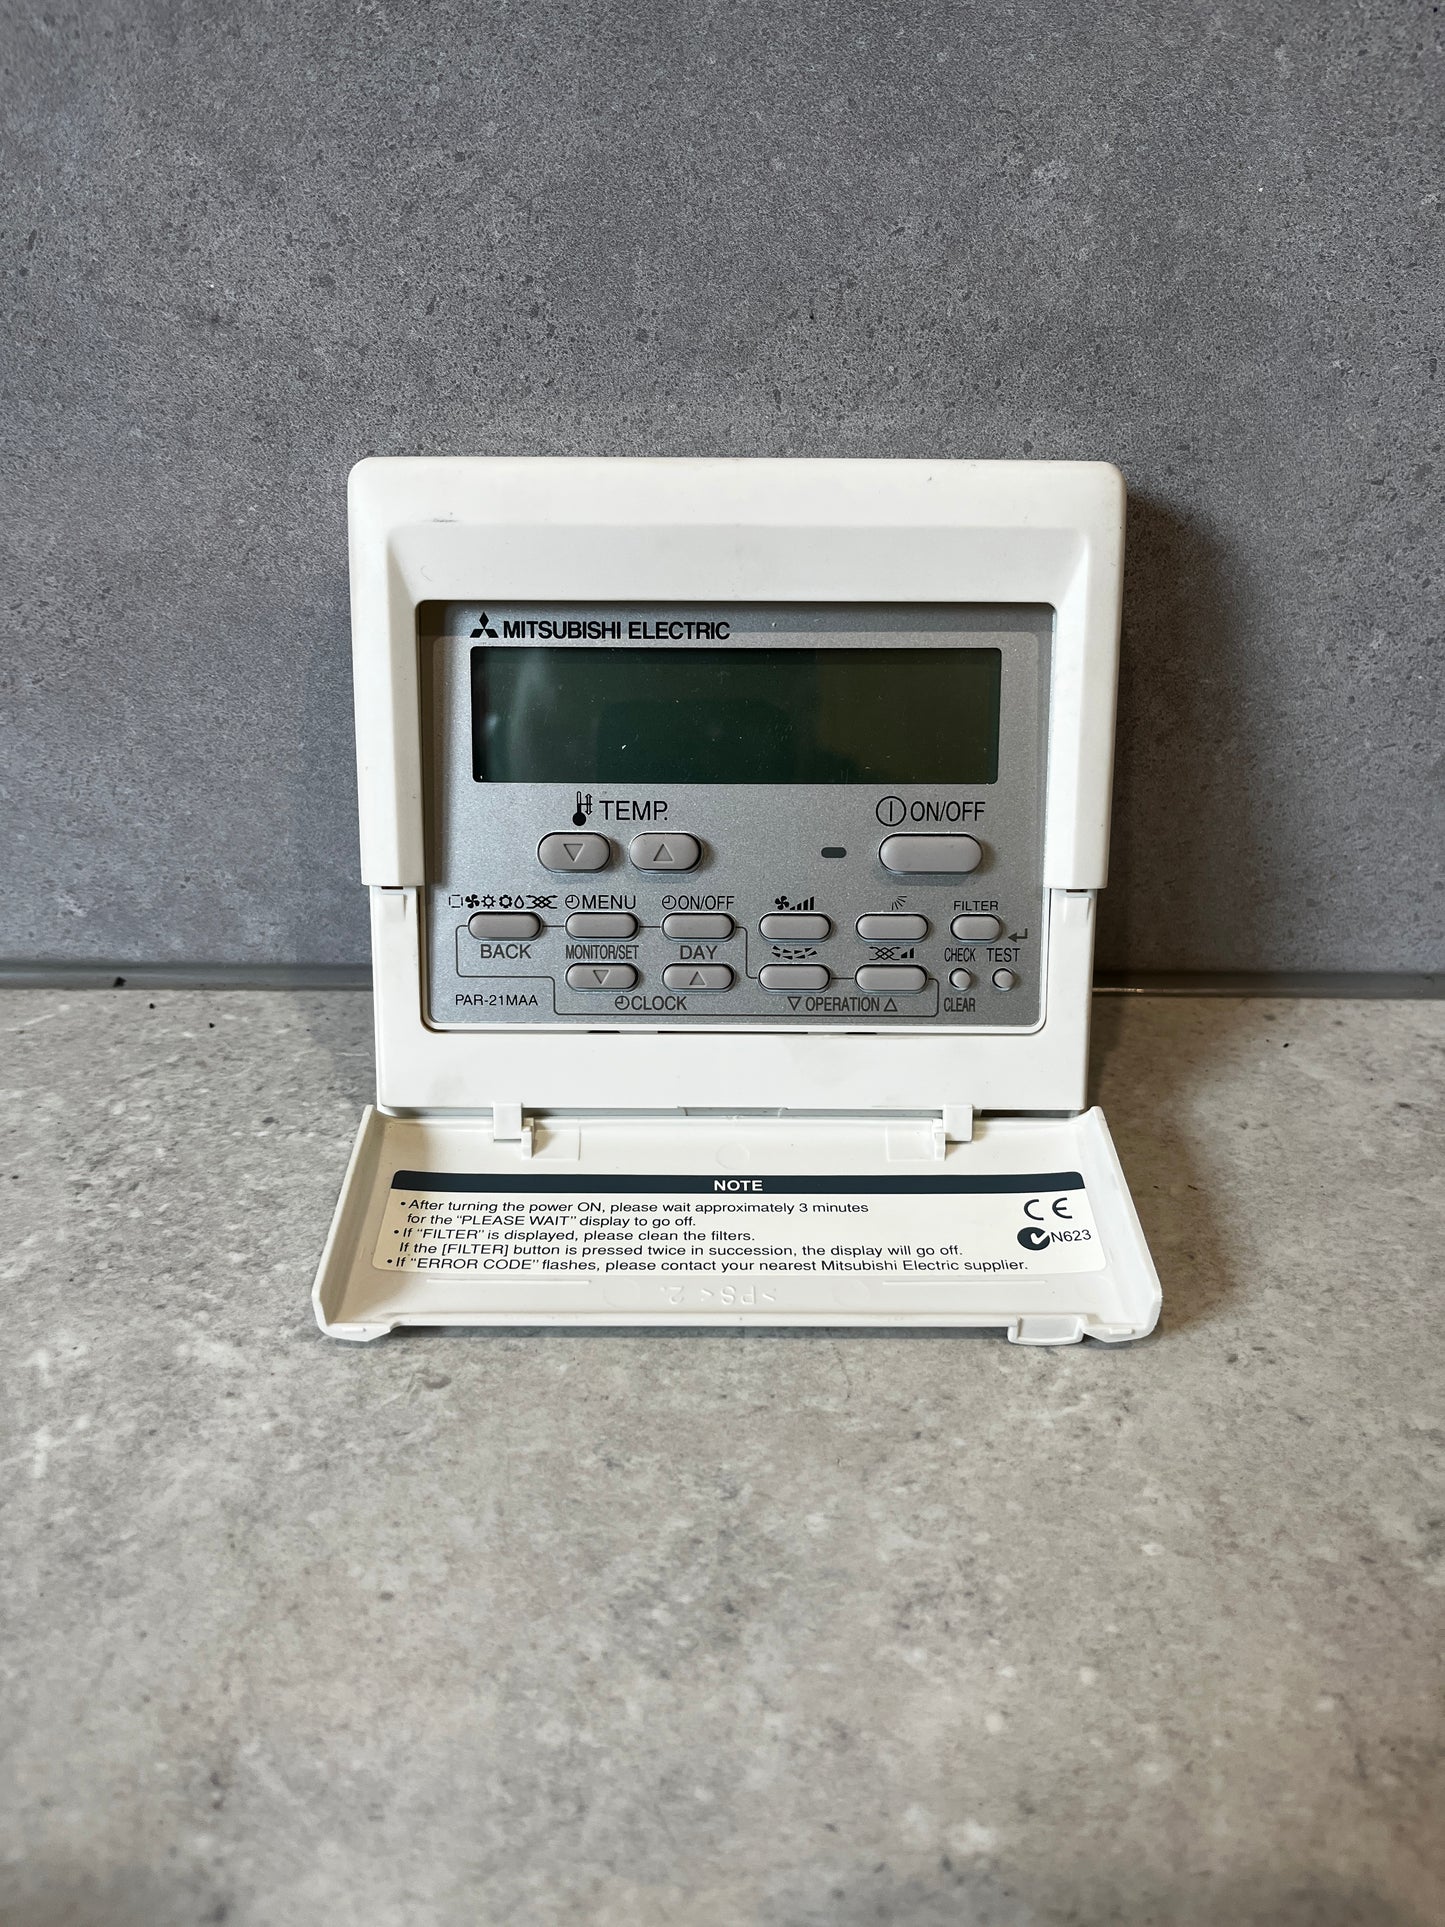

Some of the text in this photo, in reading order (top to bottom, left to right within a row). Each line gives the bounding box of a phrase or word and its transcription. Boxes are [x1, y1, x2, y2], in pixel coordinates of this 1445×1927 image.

[503, 620, 731, 641] MITSUBISHI ELECTRIC
[599, 800, 668, 821] TEMP.
[910, 801, 986, 822] ON/OFF
[582, 895, 637, 910] MENU
[678, 895, 735, 910] ON/OFF
[953, 900, 999, 911] FILTER
[480, 944, 532, 959] BACK
[565, 944, 639, 960] MONITOR/SET
[680, 945, 718, 960] DAY
[944, 947, 976, 962] CHECK
[987, 948, 1020, 962] TEST
[455, 994, 539, 1006] PAR-21MAA
[631, 995, 687, 1011] CLOCK
[805, 997, 880, 1012] OPERATION
[943, 997, 976, 1012] CLEAR
[713, 1180, 763, 1192] NOTE
[408, 1199, 869, 1215] After turning the power ON, please wait approximately 3 minutes
[1023, 1197, 1073, 1221] CE
[407, 1213, 426, 1224] for
[430, 1215, 453, 1225] the
[580, 1216, 630, 1228] display
[634, 1217, 648, 1226] to
[652, 1219, 671, 1229] go
[675, 1216, 696, 1226] off.
[402, 1228, 413, 1238] If
[487, 1230, 499, 1240] is
[504, 1230, 579, 1242] displayed,
[584, 1231, 633, 1242] please
[638, 1231, 679, 1241] clean
[683, 1231, 706, 1241] the
[711, 1231, 755, 1241] filters.
[1050, 1229, 1092, 1243] N623
[399, 1242, 963, 1258] If the [FILTER] button is pressed twice in succession, the display will go off.
[395, 1257, 406, 1267] If
[542, 1259, 600, 1272] flashes,
[605, 1260, 657, 1273] please
[661, 1261, 716, 1271] contact
[721, 1263, 755, 1273] your
[759, 1261, 816, 1271] nearest
[821, 1260, 898, 1271] Mitsubishi
[903, 1260, 960, 1271] Electric
[964, 1260, 1028, 1273] supplier.
